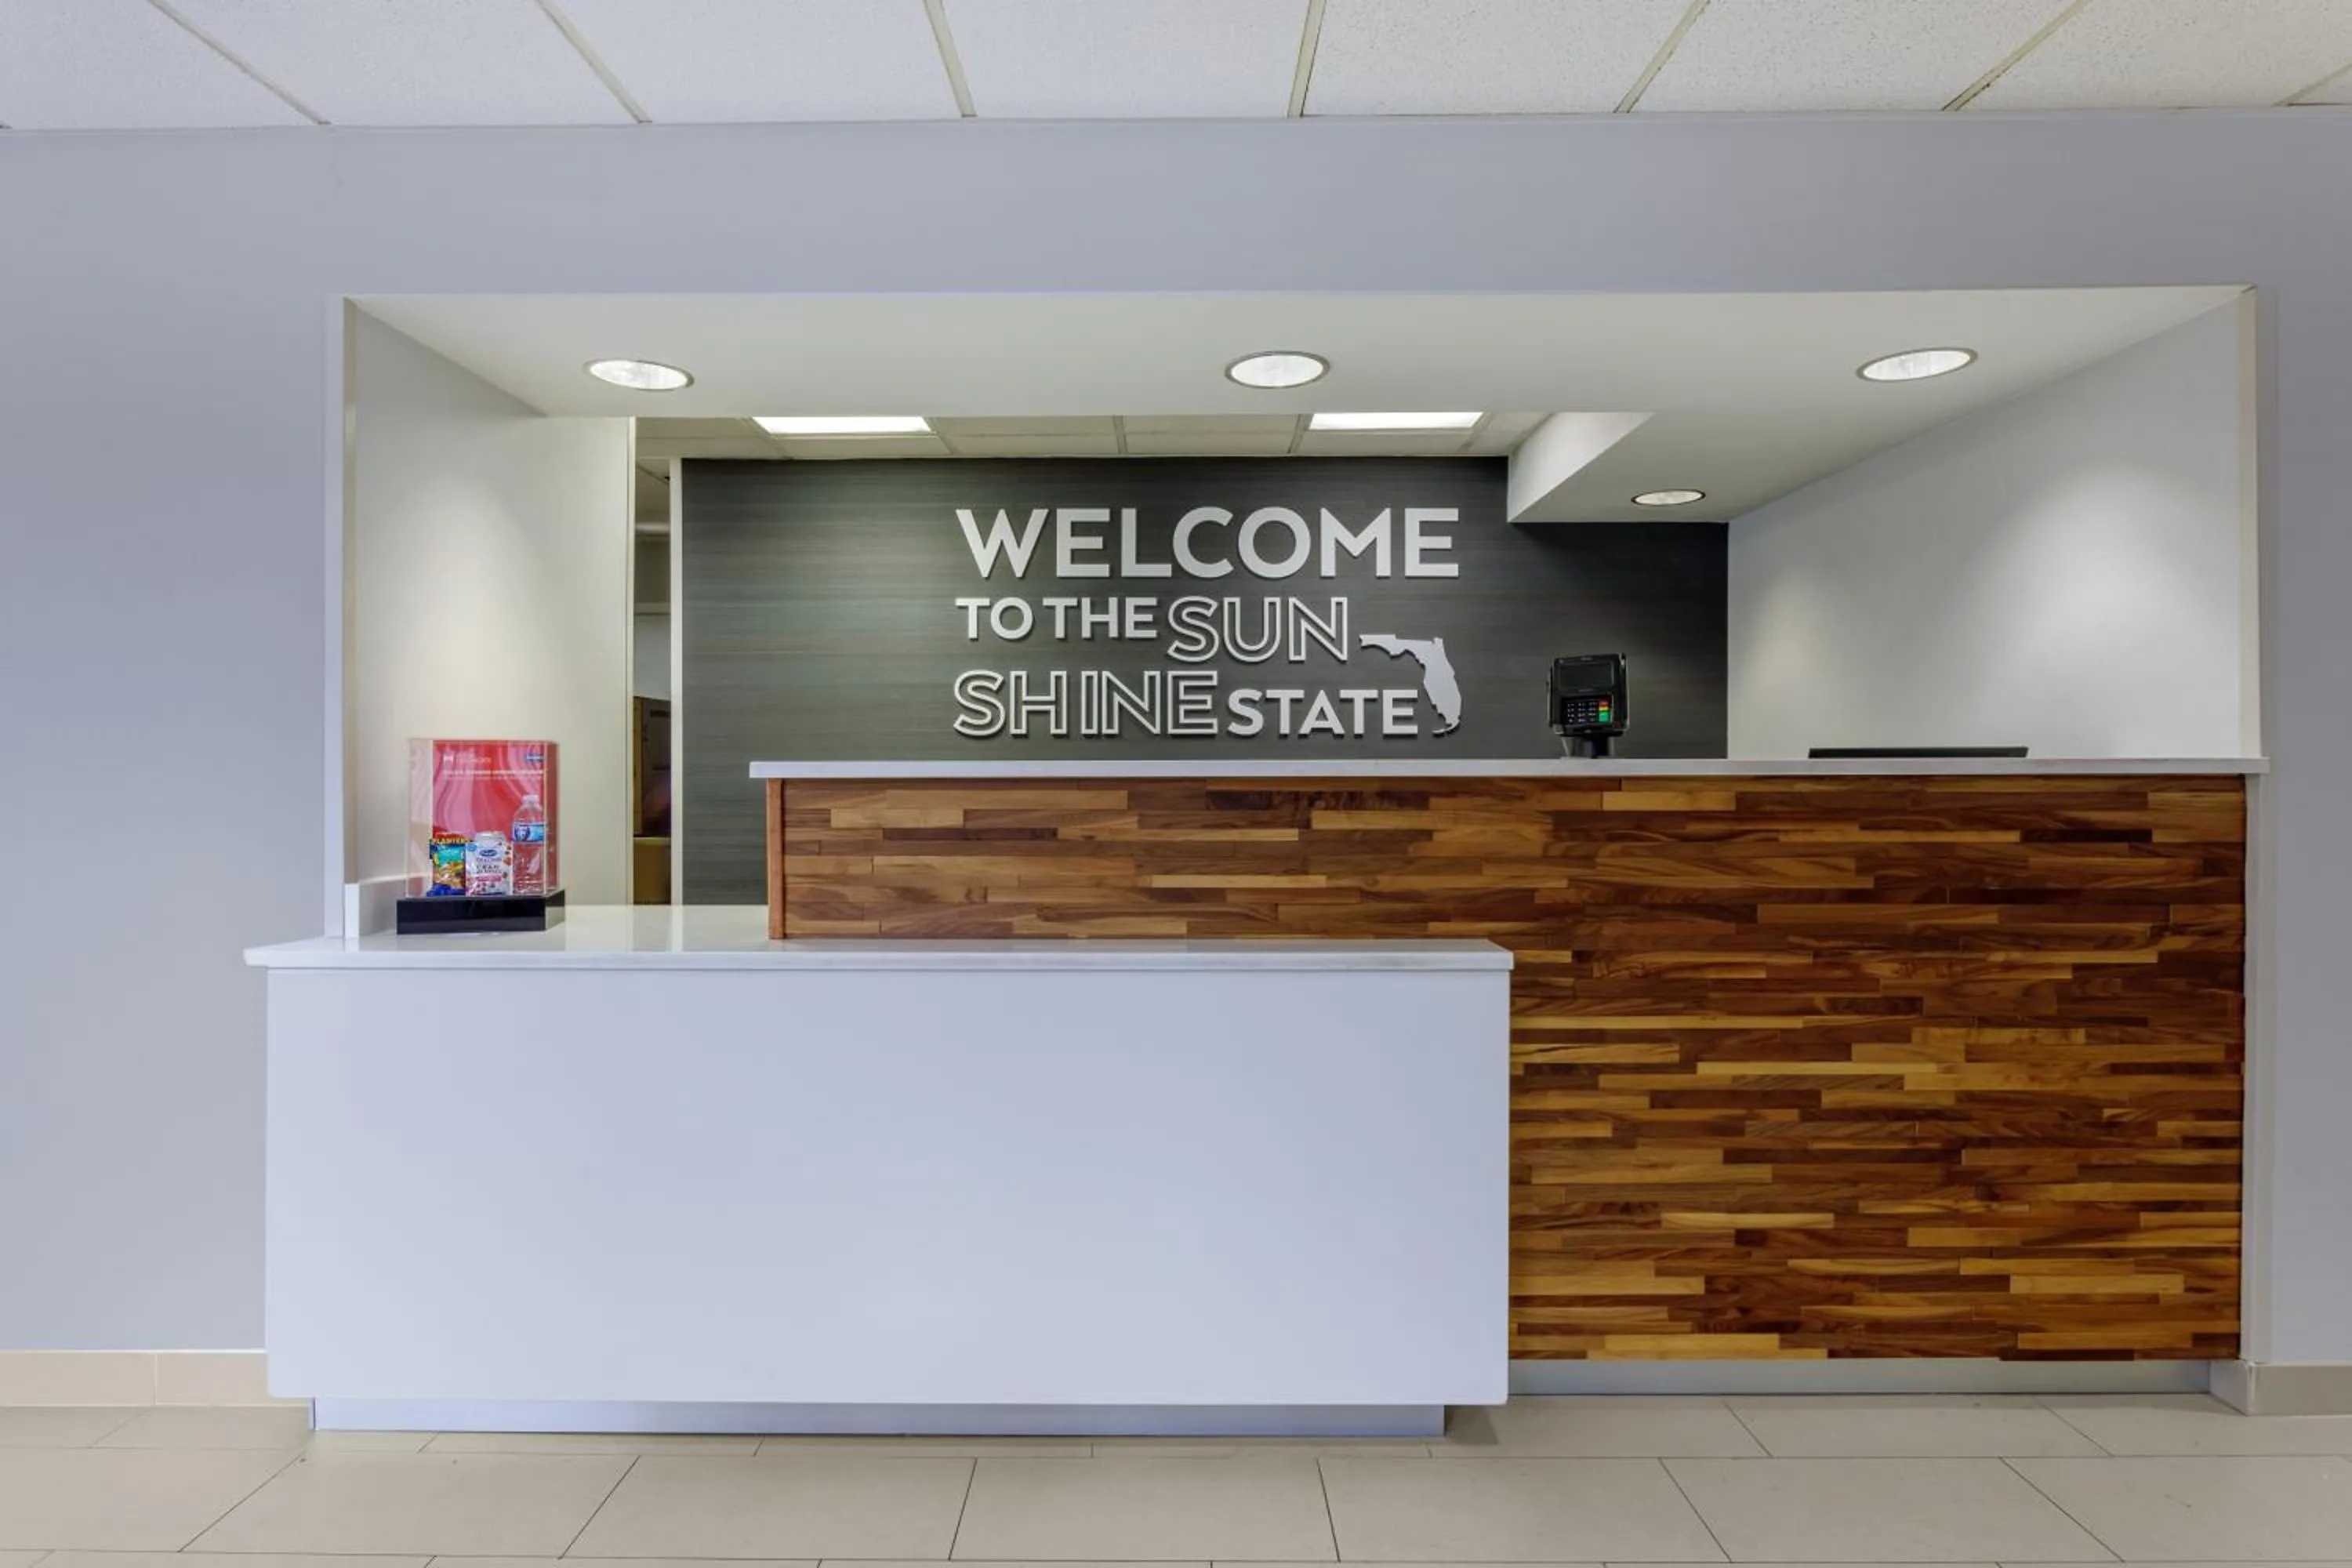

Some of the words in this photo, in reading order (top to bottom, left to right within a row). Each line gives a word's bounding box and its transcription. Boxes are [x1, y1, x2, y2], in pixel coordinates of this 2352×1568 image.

[955, 506, 1460, 579] WELCOME
[954, 597, 1033, 641] TO
[1042, 597, 1158, 640] THE
[1167, 595, 1348, 663] SUN
[953, 669, 1219, 737] SHINE
[1227, 688, 1418, 735] STATE
